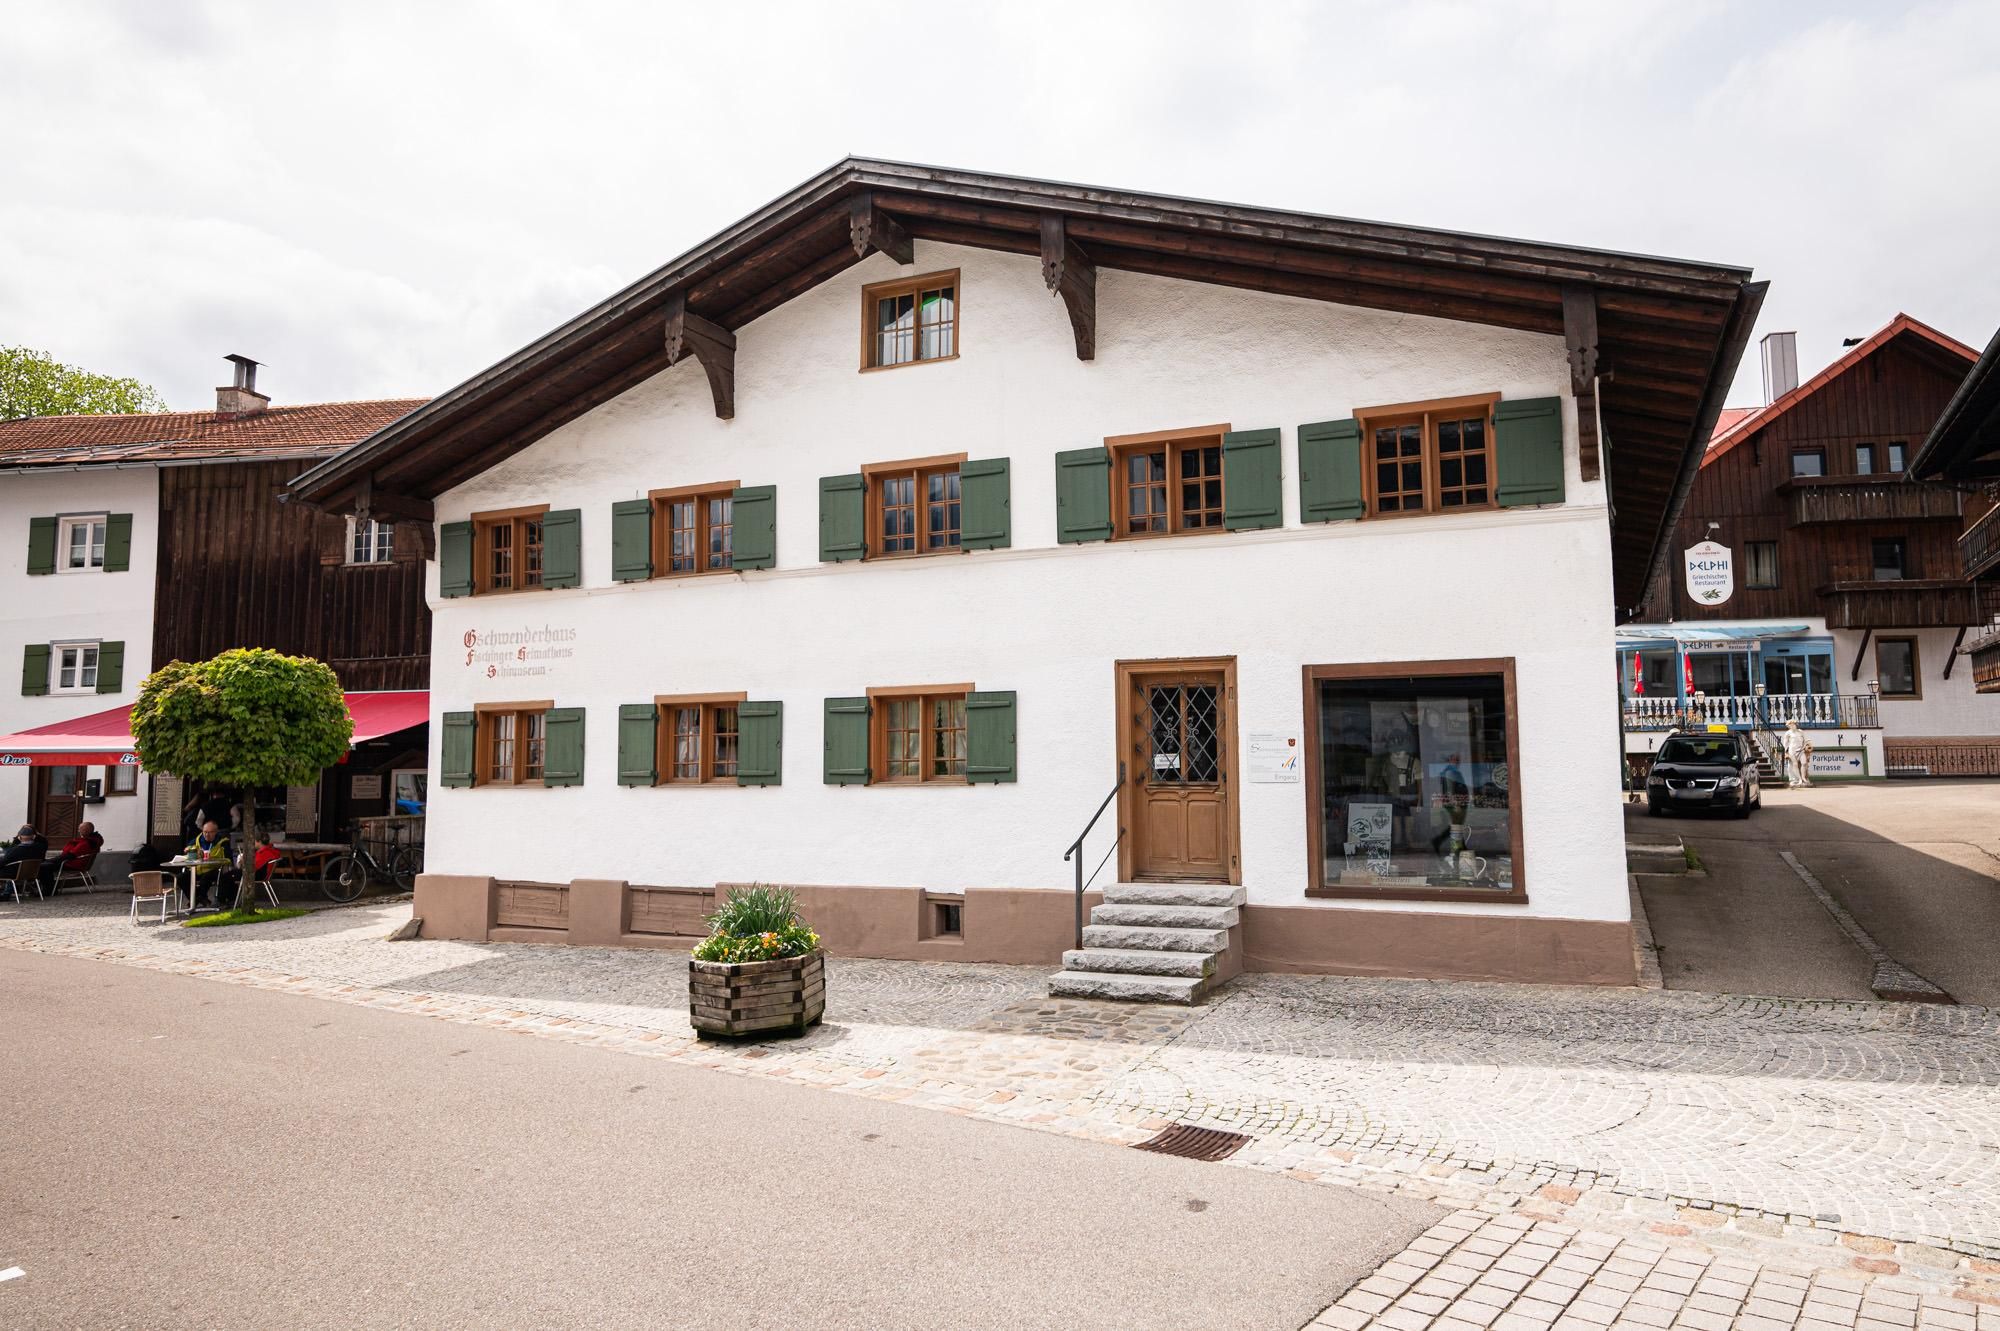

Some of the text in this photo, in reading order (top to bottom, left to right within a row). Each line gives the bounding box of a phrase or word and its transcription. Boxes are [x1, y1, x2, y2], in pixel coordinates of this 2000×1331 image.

[1689, 560, 1728, 571] DELPHI
[464, 624, 577, 648] Gschwenderhaus
[1683, 640, 1712, 650] DELPHI
